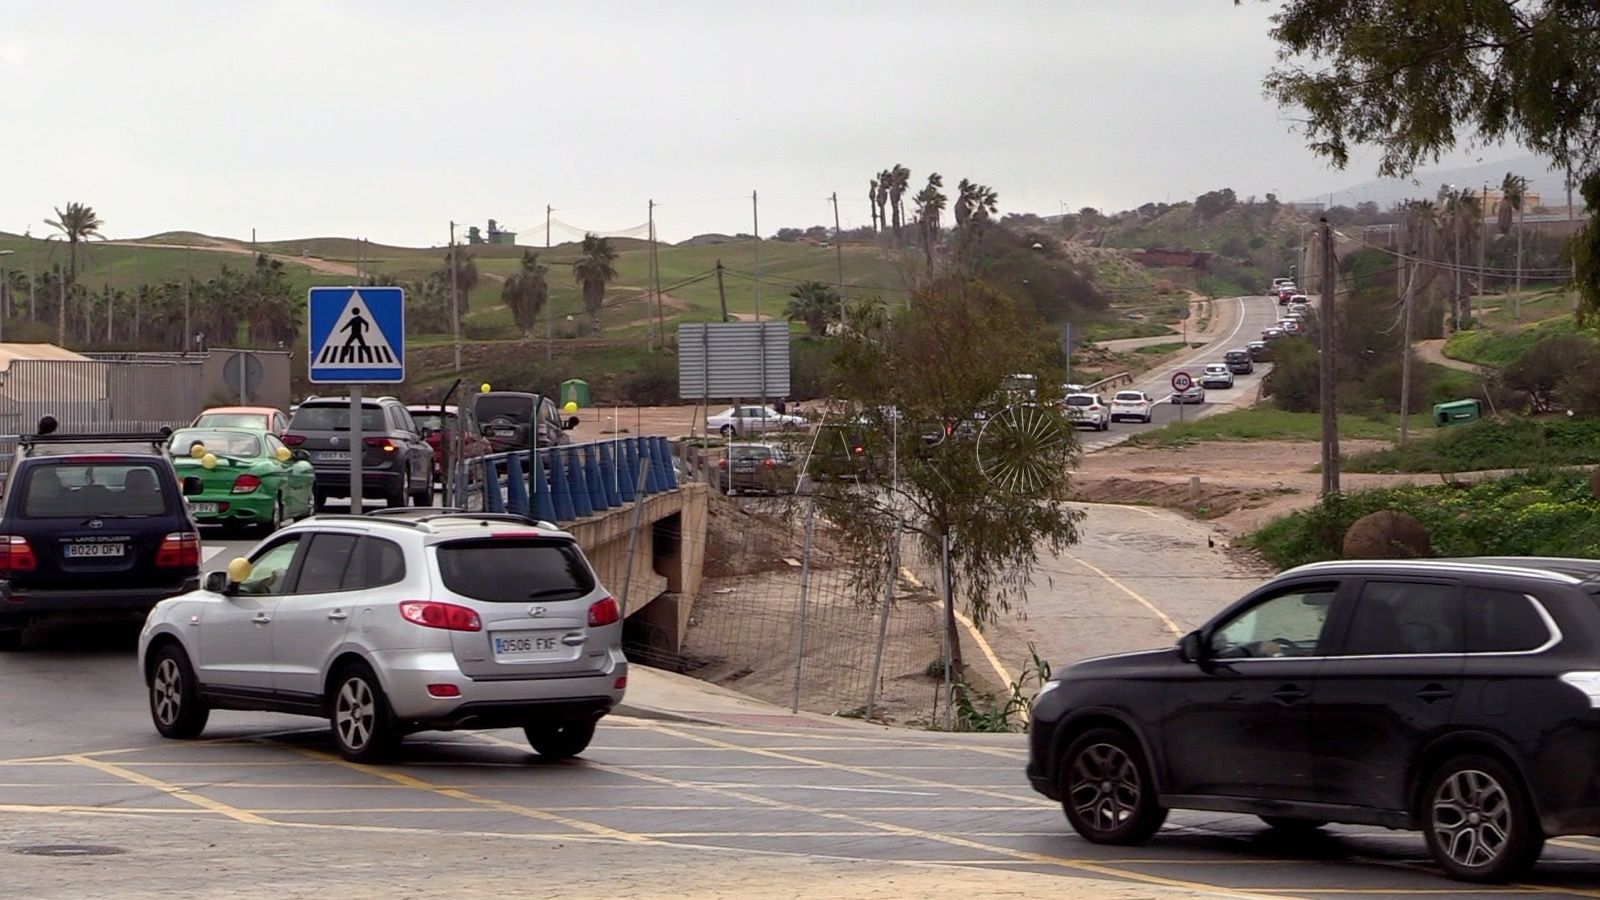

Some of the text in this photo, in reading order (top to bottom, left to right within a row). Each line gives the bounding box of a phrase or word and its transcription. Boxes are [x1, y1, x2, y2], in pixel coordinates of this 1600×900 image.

[1176, 378, 1188, 386] 40
[71, 544, 98, 555] 8020
[502, 637, 557, 652] 0506 FXF
